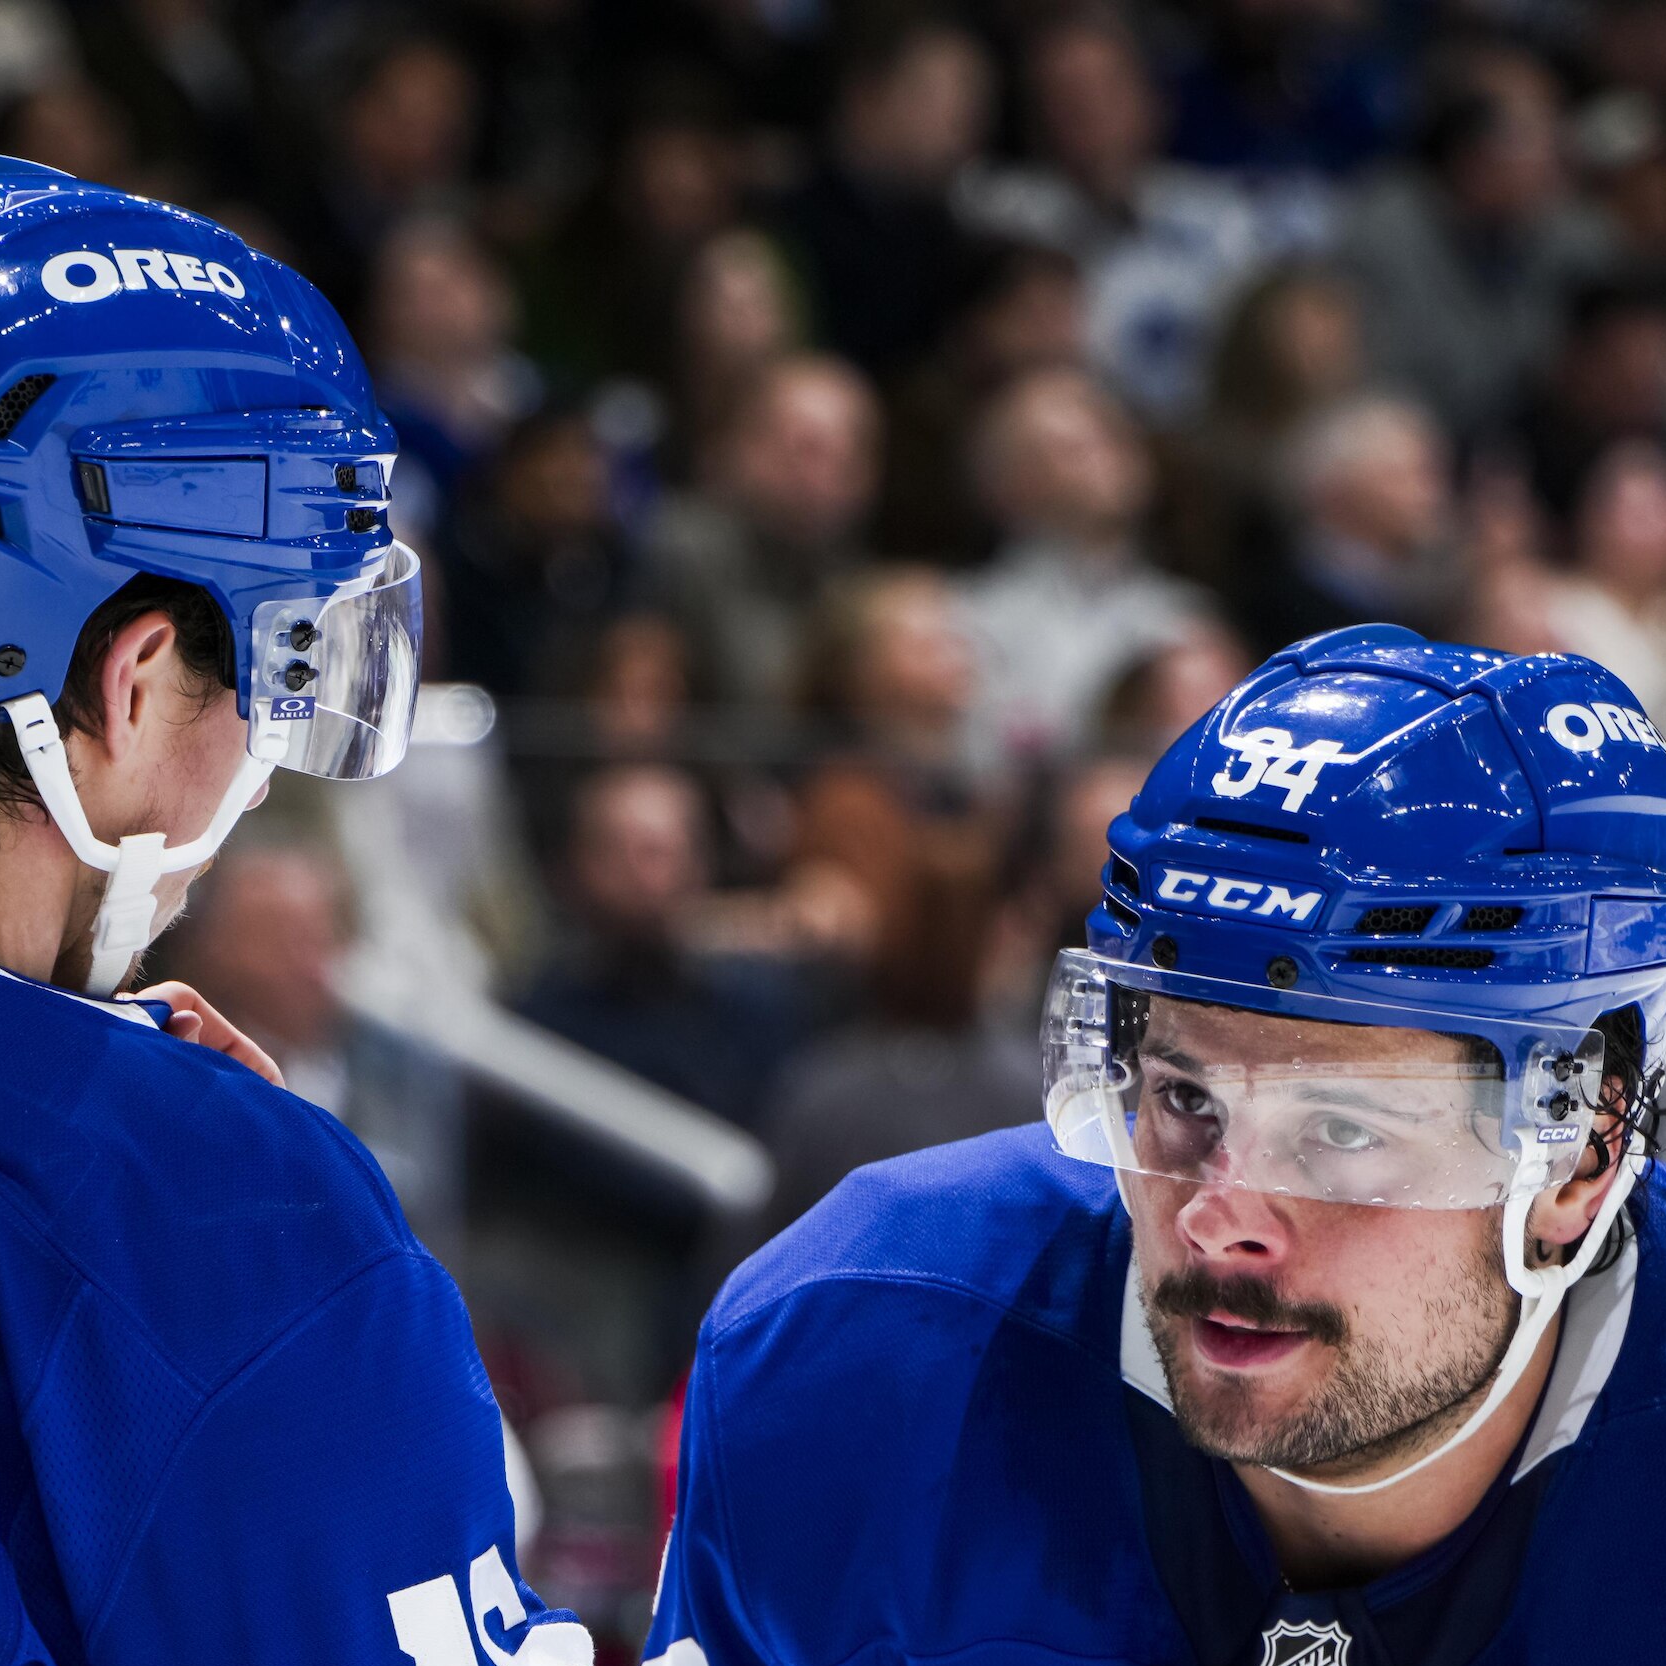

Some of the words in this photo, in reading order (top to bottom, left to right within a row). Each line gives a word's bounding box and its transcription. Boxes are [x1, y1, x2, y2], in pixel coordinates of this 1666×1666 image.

[41, 249, 245, 304] OREO
[272, 711, 311, 719] OAKLEY
[1211, 727, 1346, 813] 34
[1156, 866, 1325, 923] CCM
[1537, 1126, 1578, 1141] CCM
